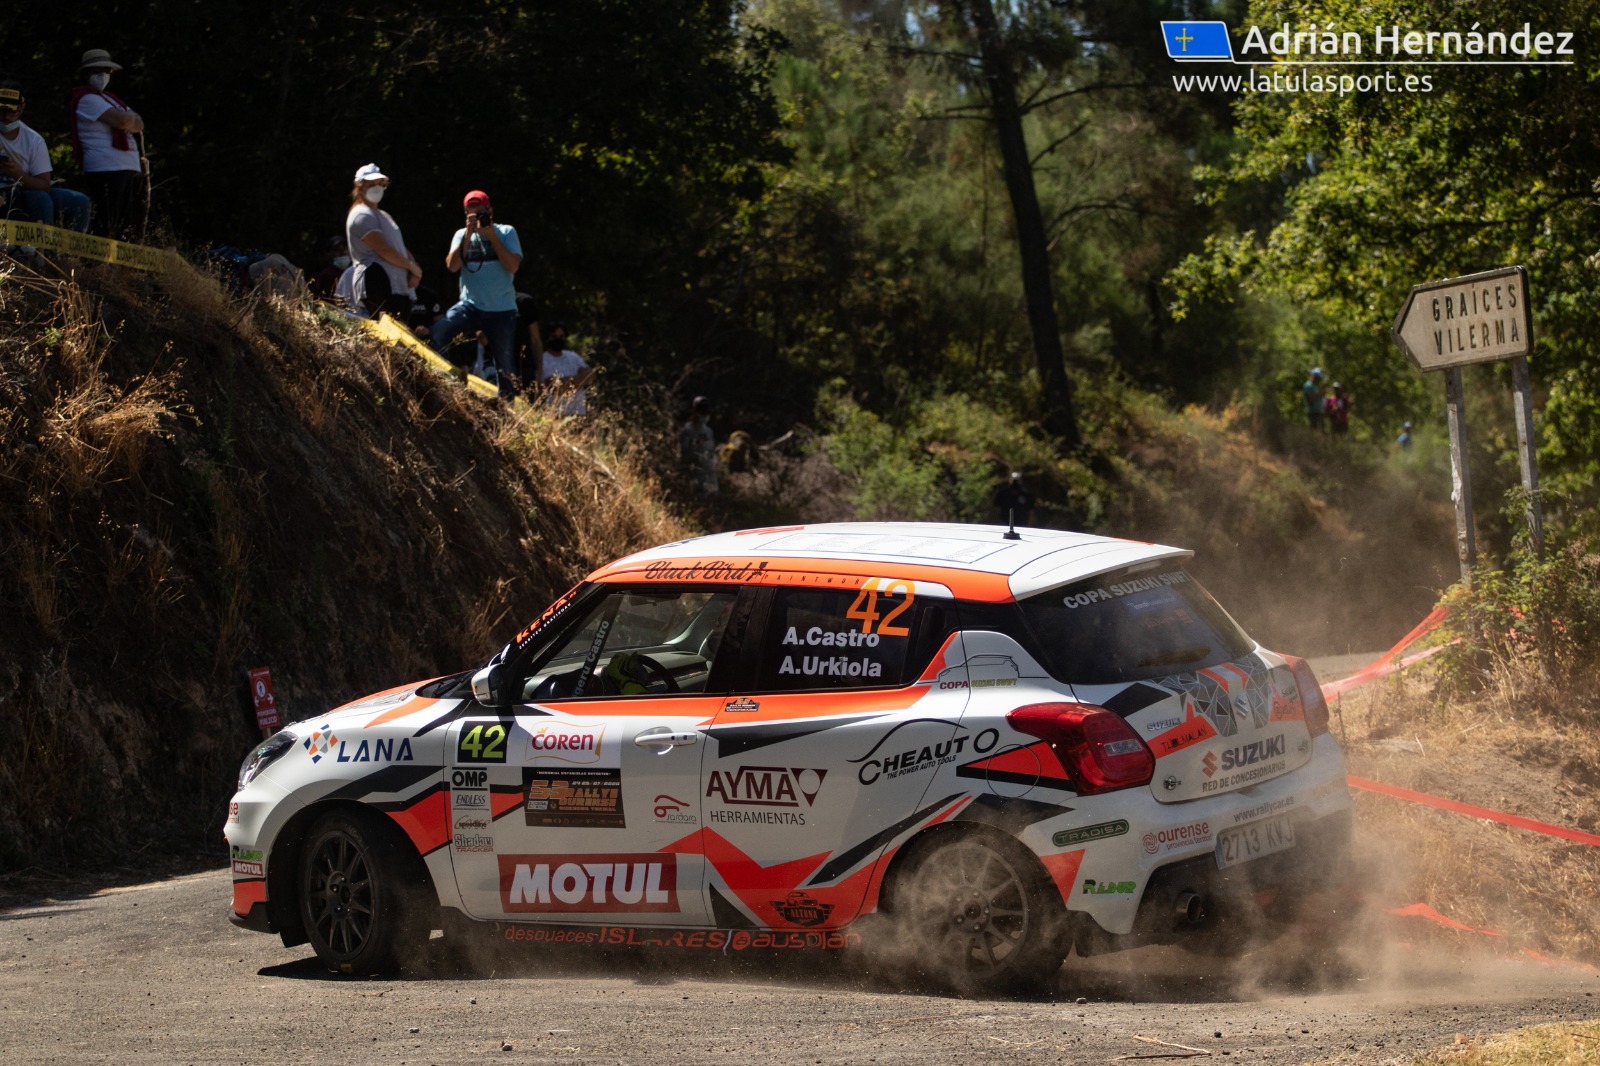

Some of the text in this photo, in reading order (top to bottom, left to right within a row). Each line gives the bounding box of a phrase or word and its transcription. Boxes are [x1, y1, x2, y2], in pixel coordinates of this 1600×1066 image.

[1434, 318, 1520, 355] VILERMA
[645, 561, 703, 580] Black
[1063, 588, 1112, 609] COPA
[1110, 576, 1162, 596] SUZUKI
[846, 577, 916, 636] 42
[782, 626, 880, 648] A.Castro
[779, 656, 882, 677] A.Urkiola
[940, 681, 969, 690] COPA
[1147, 717, 1181, 732] SUZUKI
[337, 738, 414, 763] LANA
[461, 724, 504, 759] 42
[1221, 734, 1286, 771] SUZUKI
[887, 754, 957, 780] THE POWER AUTO TOOLS
[1202, 760, 1286, 793] RED DE CONCESIONARIOS
[452, 771, 488, 787] OMP
[706, 766, 797, 802] AYMA
[456, 794, 486, 805] ENDLESS
[710, 811, 806, 826] HERRAMIENTAS
[455, 834, 494, 848] Shadow
[1058, 823, 1125, 842] TRADISA
[1158, 821, 1209, 846] ourense
[1222, 818, 1294, 862] 2713 KVJ
[1167, 839, 1194, 850] provincia
[235, 862, 262, 875] MOTUL
[509, 863, 670, 904] MOTUL
